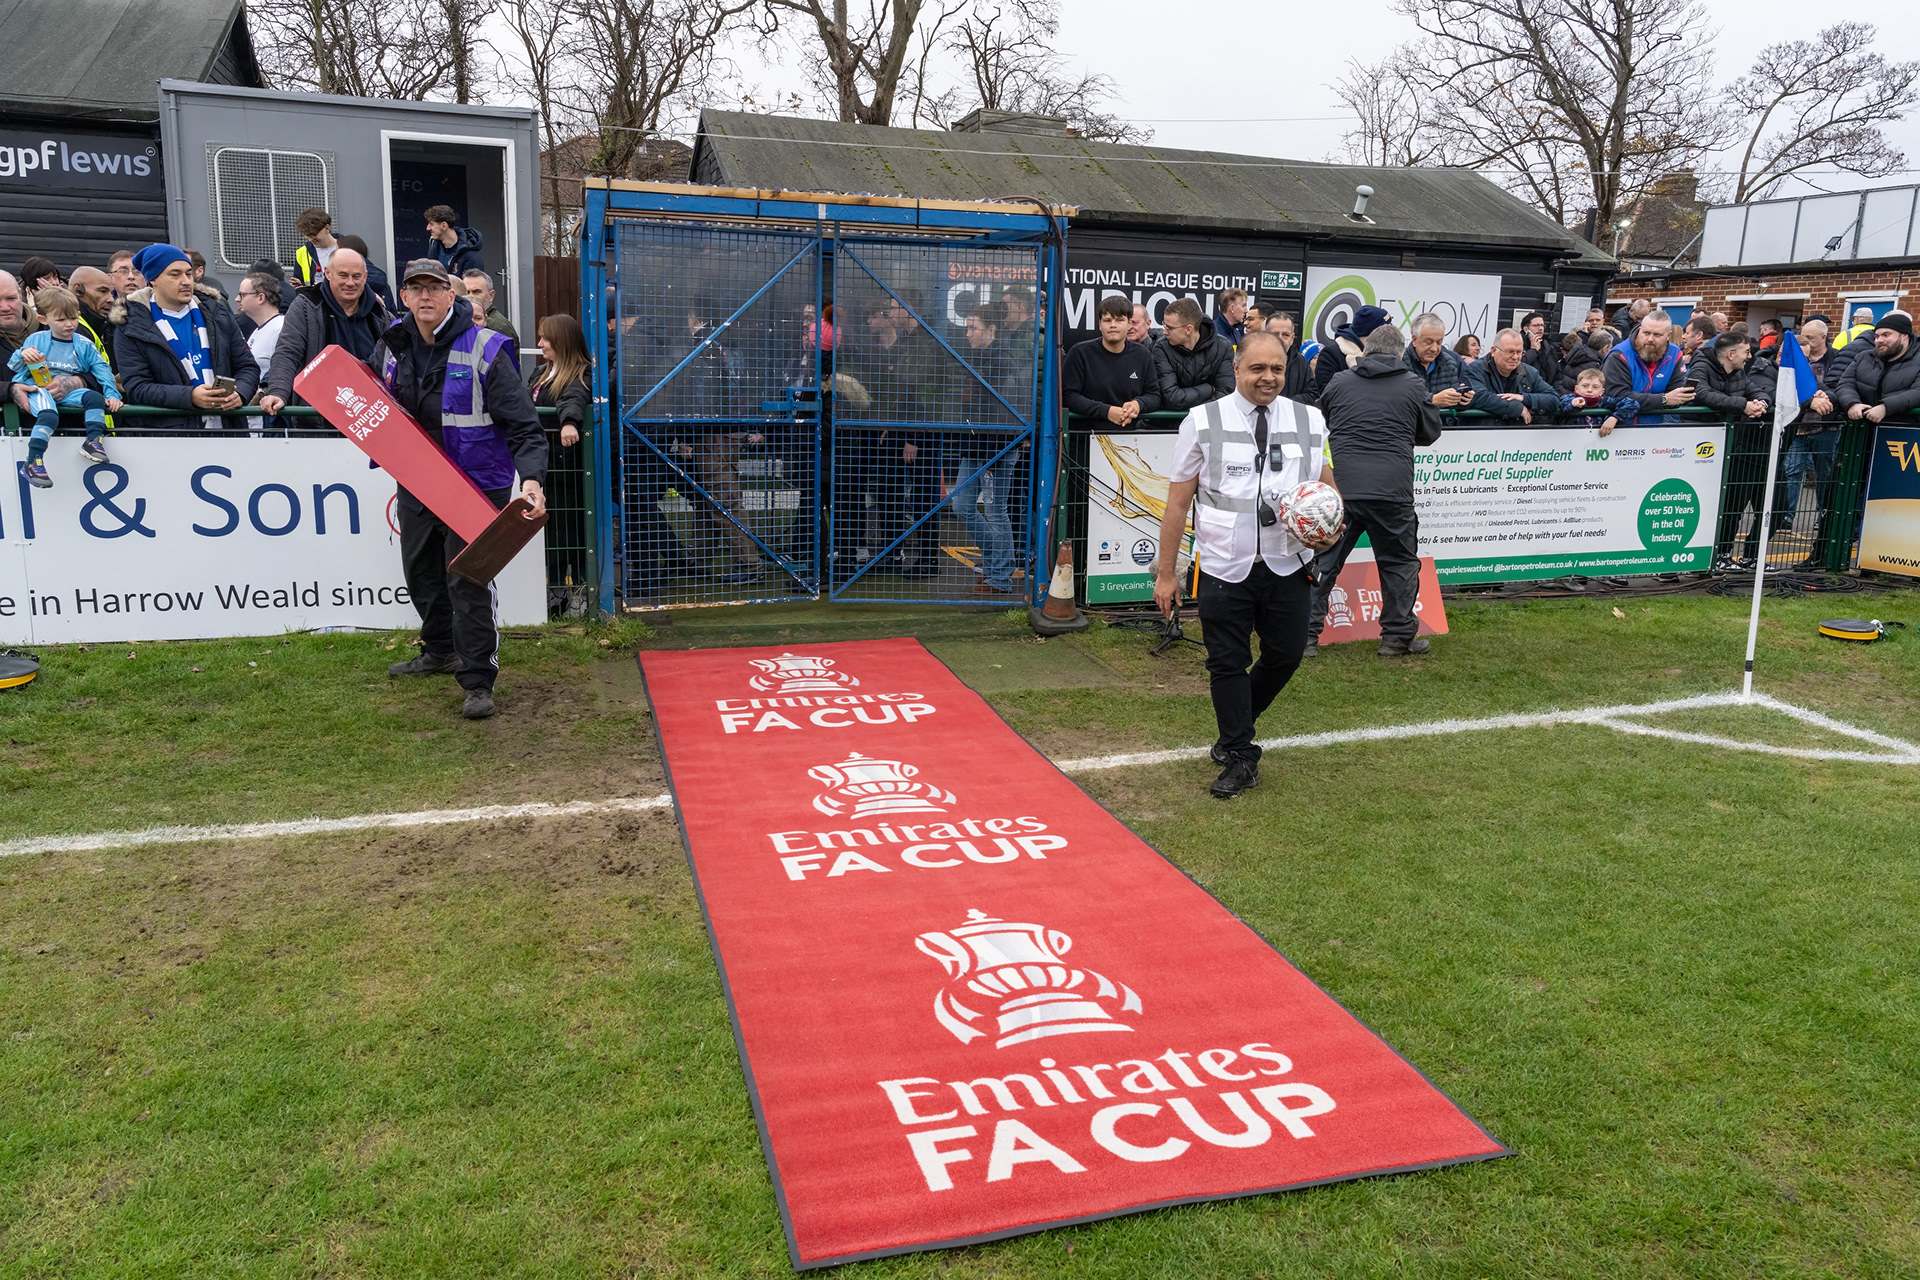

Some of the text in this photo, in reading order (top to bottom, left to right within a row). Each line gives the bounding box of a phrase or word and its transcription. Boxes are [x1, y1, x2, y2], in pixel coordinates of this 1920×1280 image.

[1135, 271, 1198, 289] LEAGUE
[1202, 275, 1256, 292] SOUTH
[348, 399, 384, 433] Emirates
[355, 405, 390, 441] FA CUP
[1586, 449, 1610, 461] HVO
[1697, 446, 1713, 455] JET
[1436, 453, 1464, 468] your
[1466, 450, 1498, 463] Local
[1501, 449, 1572, 466] Independent
[1433, 468, 1475, 482] Owned
[1477, 467, 1502, 480] Fuel
[1505, 467, 1553, 482] Supplier
[1424, 486, 1431, 495] in
[1432, 486, 1451, 495] Fuels
[1453, 486, 1458, 494] &
[1460, 485, 1498, 494] Lubricants
[1507, 482, 1547, 493] Exceptional
[1549, 482, 1582, 491] Customer
[1584, 482, 1608, 490] Service
[79, 463, 156, 539] &
[190, 464, 360, 538] Son
[1450, 499, 1472, 507] efficient
[1472, 499, 1493, 507] delivery
[1533, 497, 1558, 505] Supplying
[1650, 492, 1692, 502] Celebrating
[1441, 510, 1470, 519] agriculture
[1645, 506, 1694, 515] over 50 Years
[1457, 521, 1476, 529] heating
[1582, 516, 1604, 524] products
[1652, 519, 1684, 529] in the Oil
[1455, 535, 1470, 543] how
[1509, 532, 1517, 540] of
[1518, 532, 1533, 541] help
[1534, 531, 1550, 540] with
[1552, 532, 1568, 540] your
[1569, 530, 1583, 538] fuel
[1584, 529, 1607, 537] needs!
[1651, 533, 1682, 543] Industry
[1578, 555, 1665, 567] www.bartonpetroleum.co.uk
[1099, 582, 1106, 591] 3
[1107, 581, 1145, 592] Greycaine
[30, 589, 61, 616] in
[75, 586, 204, 614] Harrow
[215, 581, 319, 610] Weald
[331, 581, 410, 606] since
[720, 703, 937, 734] FA CUP
[766, 816, 1048, 854] Emirates
[779, 835, 1069, 881] FA CUP
[876, 1043, 1293, 1125] Emirates
[906, 1082, 1337, 1192] FA CUP
